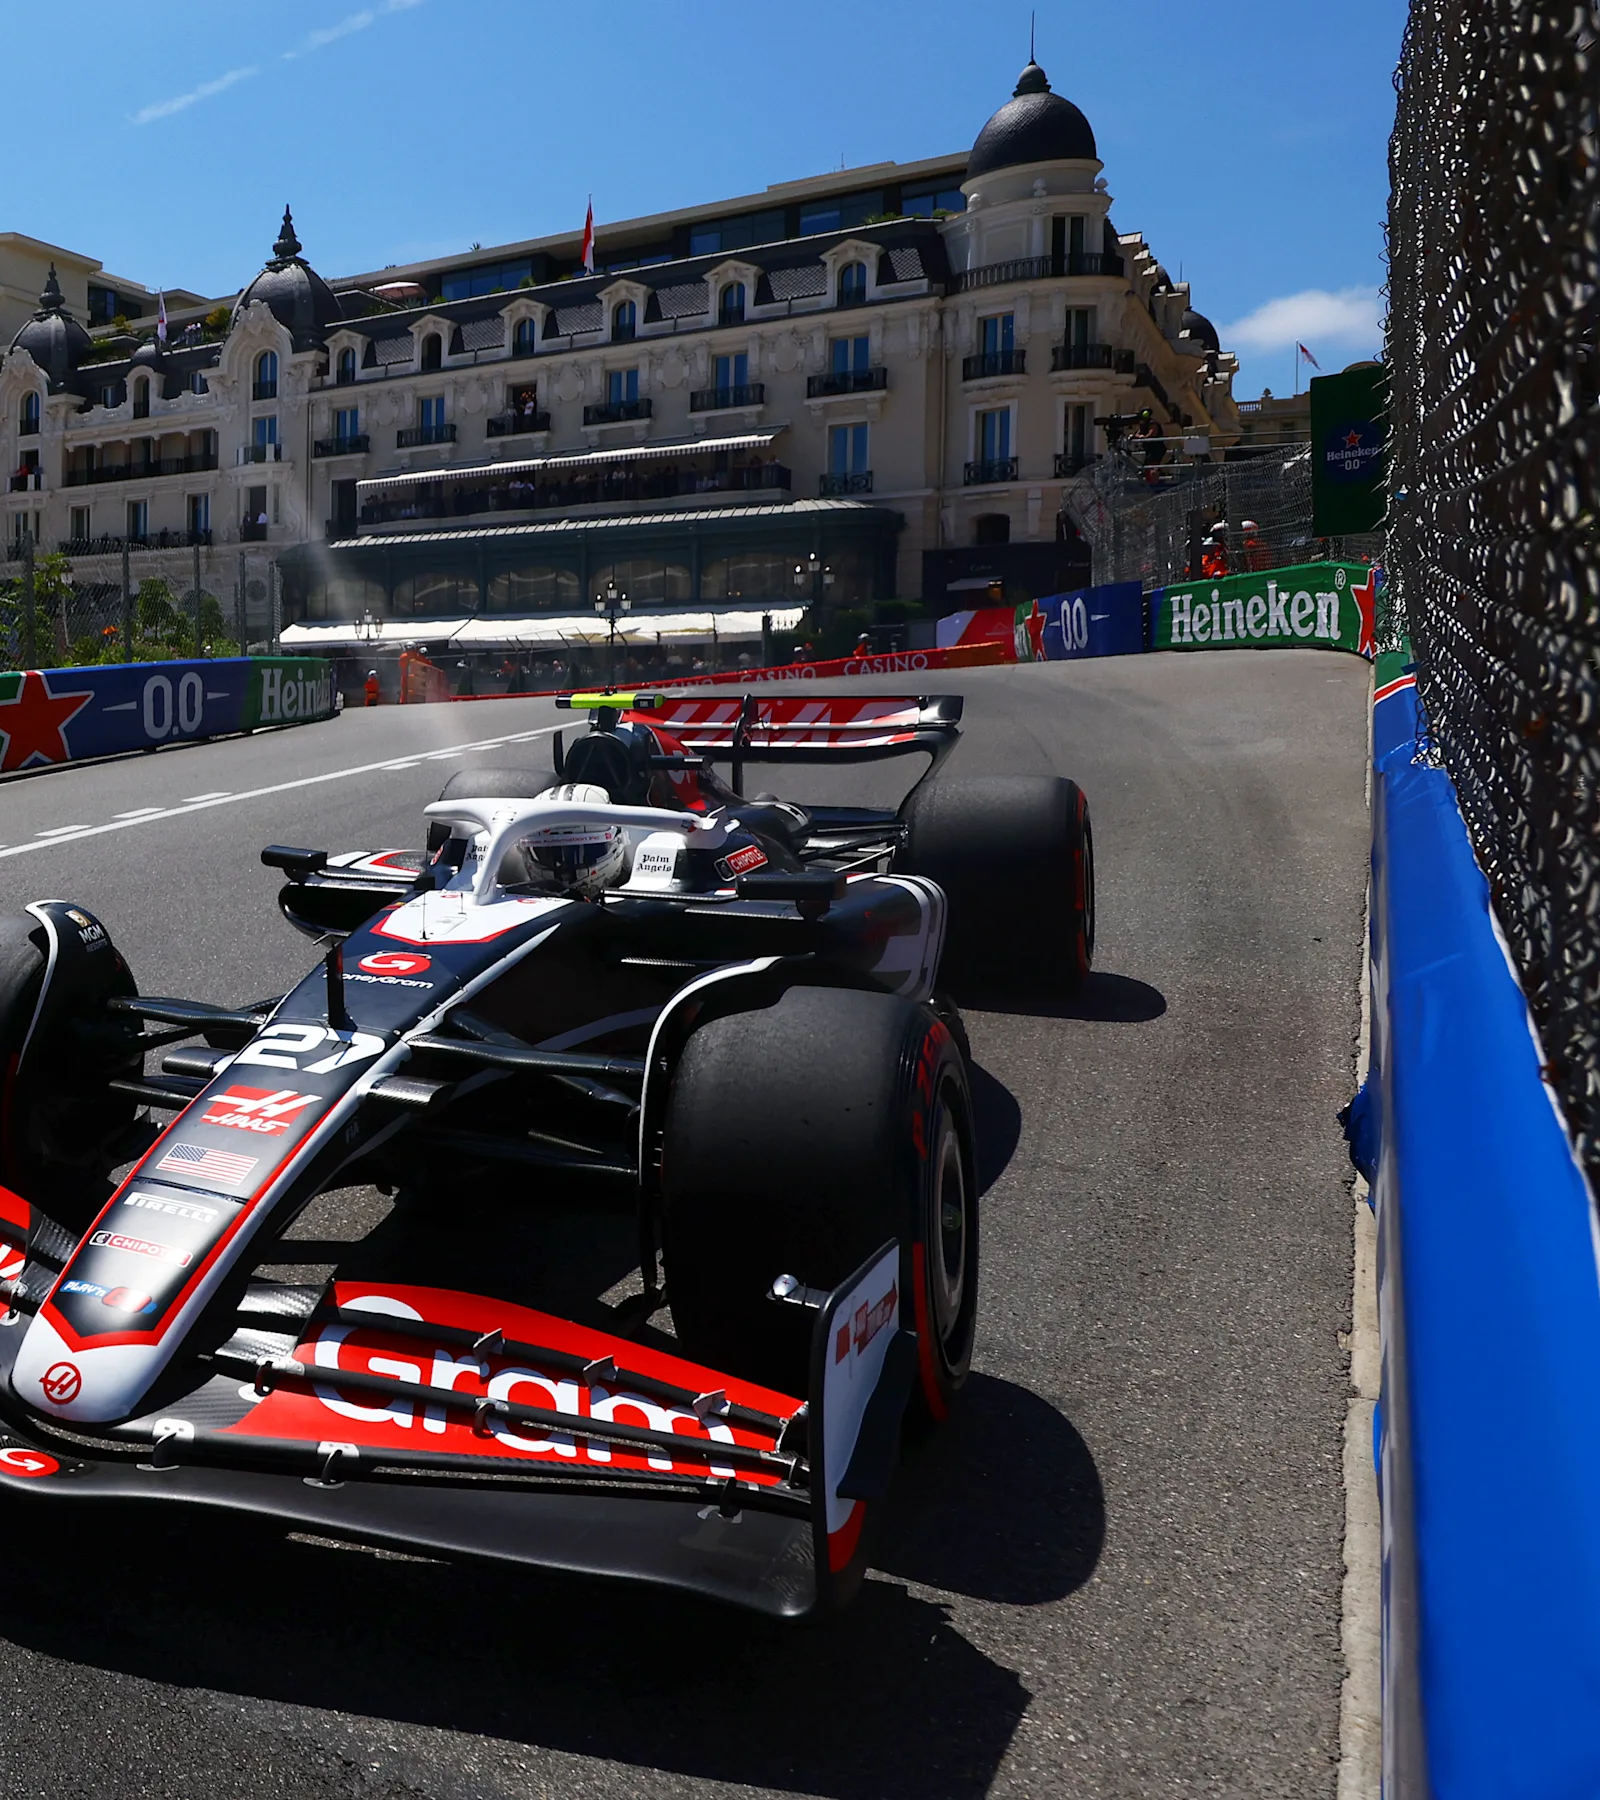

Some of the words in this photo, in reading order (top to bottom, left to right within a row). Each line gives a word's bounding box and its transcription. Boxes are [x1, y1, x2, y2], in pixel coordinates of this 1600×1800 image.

[1326, 444, 1380, 461] Heineken
[1060, 596, 1088, 650] 0.0
[843, 653, 928, 675] CASINO
[142, 671, 204, 740] 0.0
[637, 863, 672, 873] Angels
[642, 854, 669, 863] Palm
[730, 849, 764, 871] CHIPOTLE
[78, 924, 104, 944] MGM
[233, 1023, 386, 1074] 27
[202, 1112, 290, 1132] HAAS
[123, 1191, 219, 1223] PIRELLI
[112, 1236, 187, 1265] CHIPOT
[311, 1295, 736, 1478] Gram
